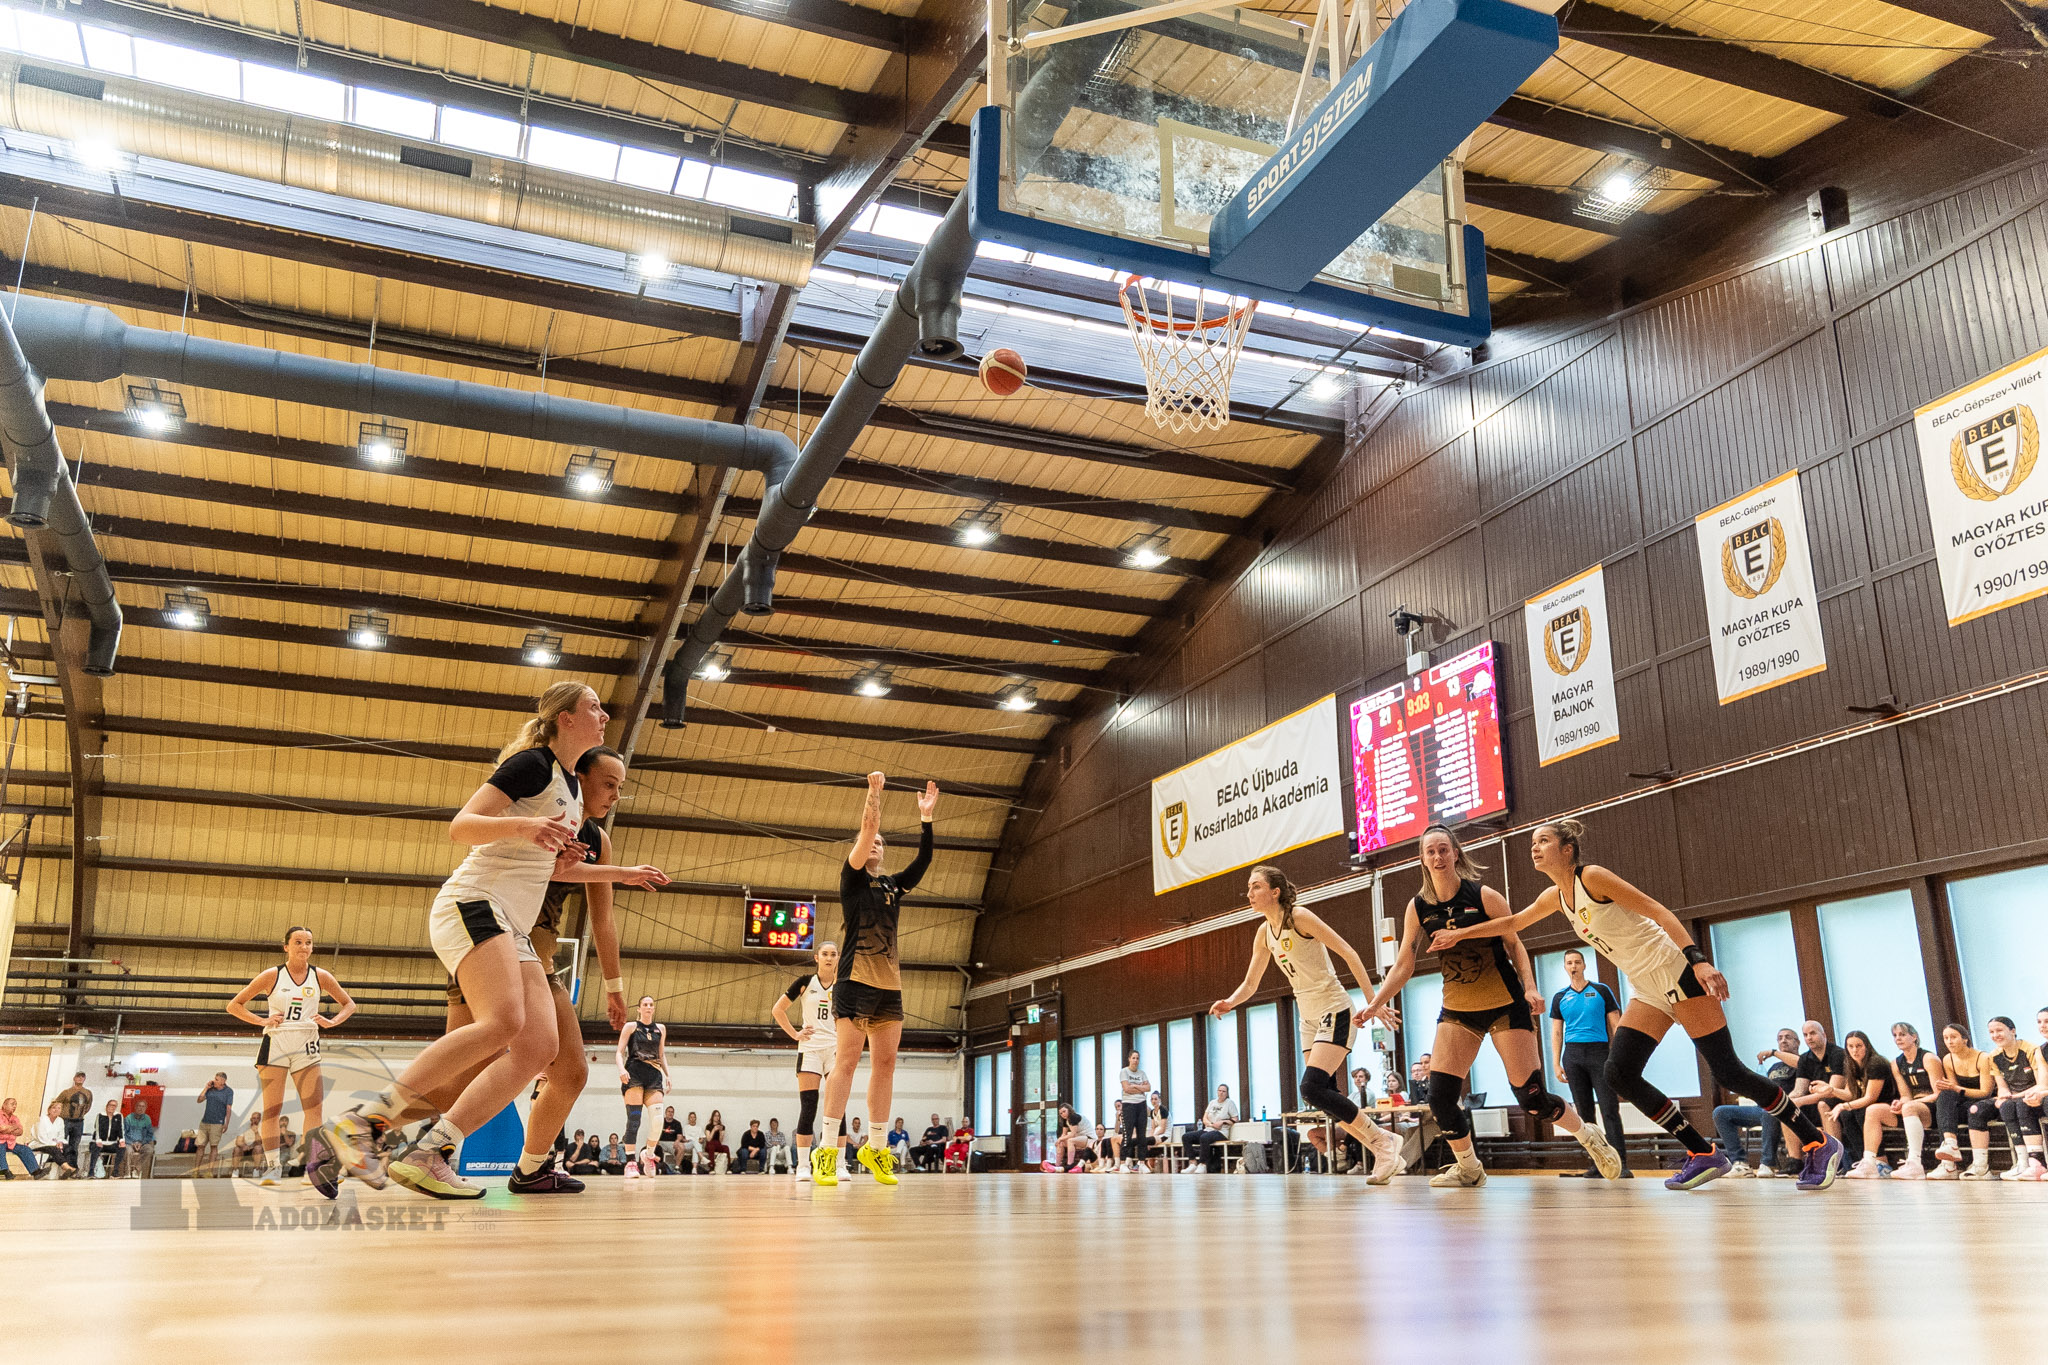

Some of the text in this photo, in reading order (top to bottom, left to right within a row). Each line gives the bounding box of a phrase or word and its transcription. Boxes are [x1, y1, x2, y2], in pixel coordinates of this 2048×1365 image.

[1247, 62, 1373, 211] SPORT SYSTEM
[1932, 370, 2042, 428] BEAC-Gépszev-Villért
[1967, 416, 2013, 444] BEAC
[1980, 435, 2009, 475] E
[1719, 497, 1776, 528] BEAC-Gépszev
[1735, 524, 1769, 548] BEAC
[1951, 513, 2016, 548] MAGYAR
[1973, 521, 2046, 559] GYŐZTES
[1744, 543, 1764, 576] E
[1542, 587, 1586, 612] BEAC-Gépszev
[1553, 612, 1579, 631] BEAC
[1721, 597, 1804, 637] MAGYAR KUPA
[1560, 628, 1575, 656] E
[1737, 619, 1791, 648] GYŐZTES
[1738, 649, 1800, 682] 1989/1990
[1446, 676, 1460, 698] 13
[1551, 680, 1594, 705] MAGYAR
[1407, 692, 1430, 717] 9:03
[1437, 701, 1444, 716] 0
[1553, 697, 1595, 722] BAJNOK
[1379, 707, 1391, 727] 21
[1397, 719, 1403, 732] 3
[1554, 721, 1600, 748] 1989/1990
[1217, 760, 1298, 807] BEAC Újbuda
[1166, 802, 1182, 819] BEAC
[1194, 804, 1258, 842] Kosárlabda
[1262, 776, 1329, 816] Akadémia
[1170, 818, 1178, 841] E
[752, 902, 770, 917] 21
[775, 912, 785, 926] 2
[794, 905, 809, 919] 13
[752, 920, 761, 934] 3
[768, 930, 798, 946] 9:03
[798, 923, 808, 936] 0
[285, 1006, 302, 1021] 15
[817, 1007, 829, 1020] 18
[305, 1041, 317, 1056] 15
[1909, 1075, 1919, 1086] 11
[1672, 1119, 1689, 1136] FILA
[466, 1162, 490, 1170] SPORT
